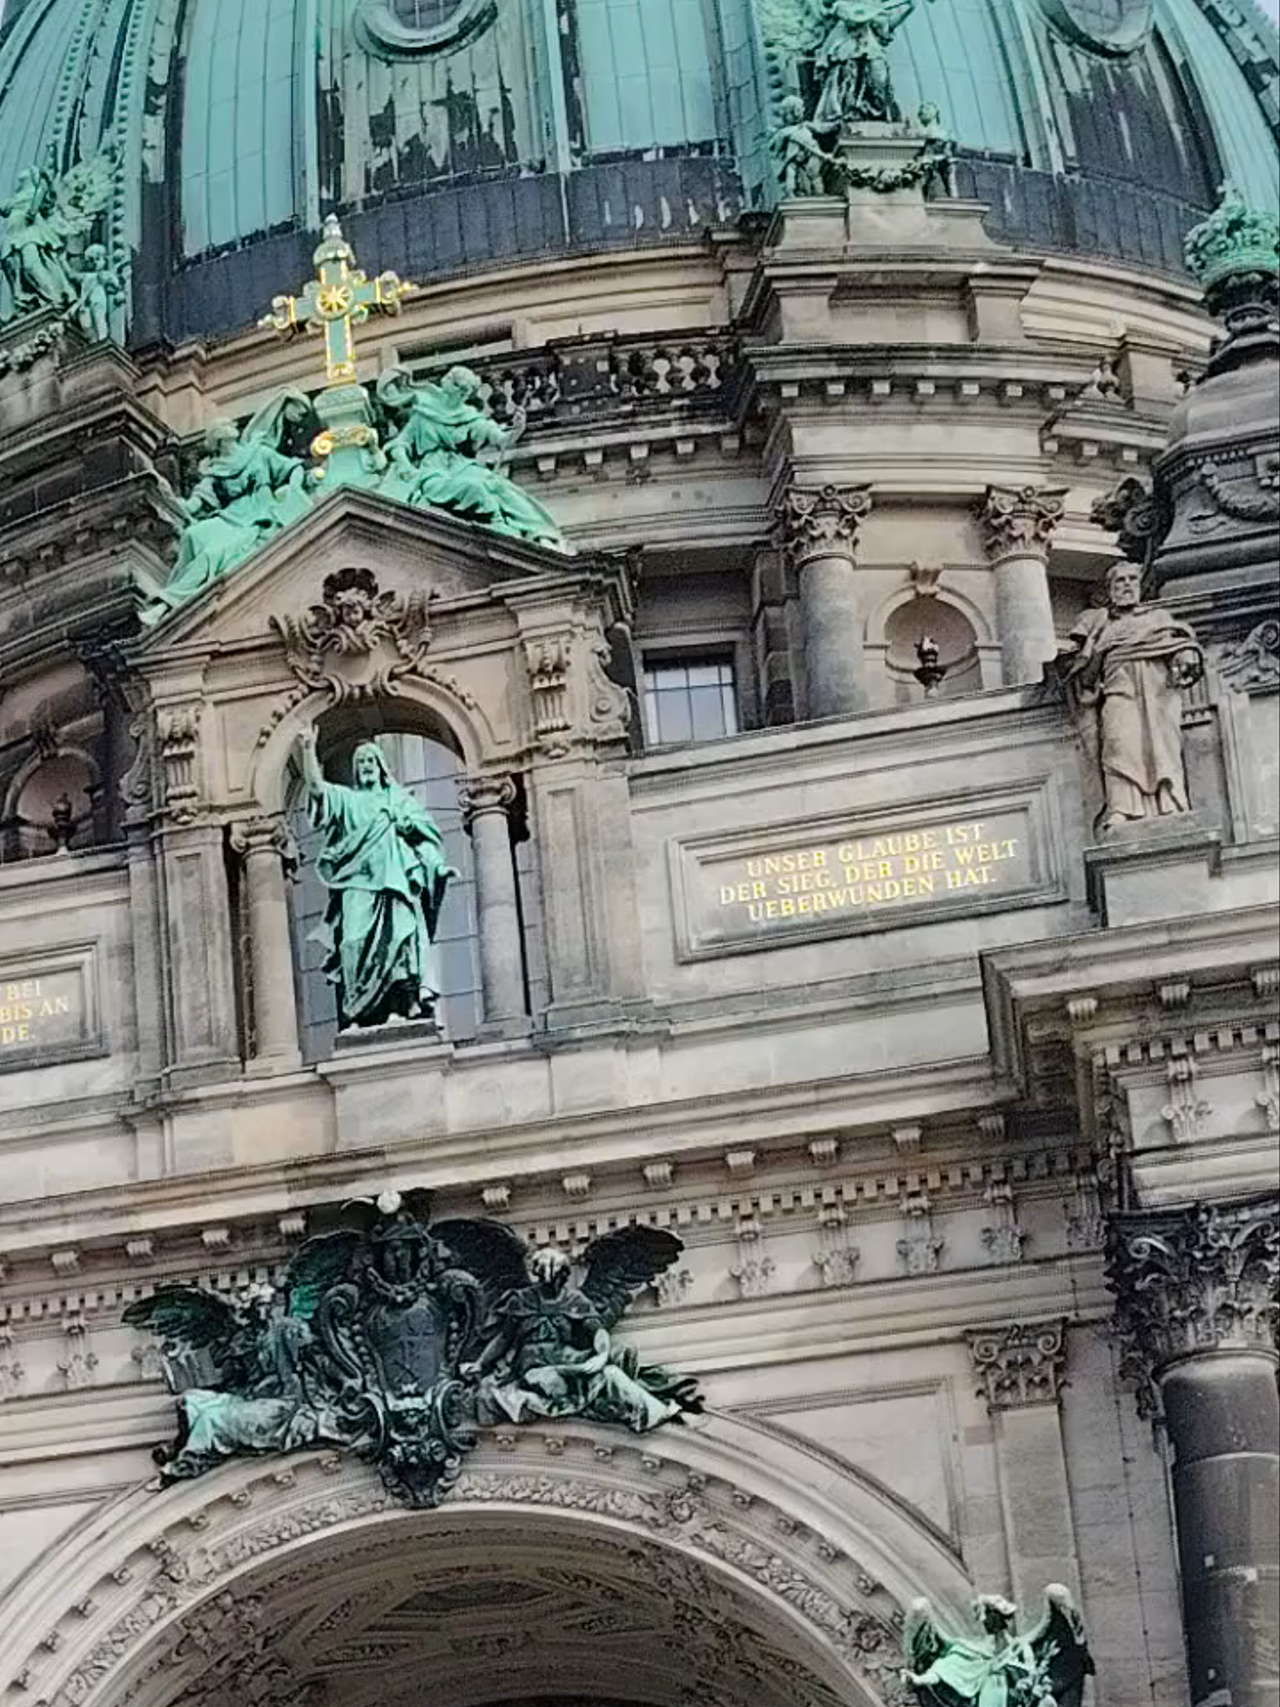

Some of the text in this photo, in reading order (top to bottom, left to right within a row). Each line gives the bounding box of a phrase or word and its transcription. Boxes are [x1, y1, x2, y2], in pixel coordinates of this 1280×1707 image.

[720, 881, 767, 905] DER
[845, 861, 892, 885] DER
[904, 852, 946, 875] DIE
[955, 838, 1018, 867] WELT
[746, 823, 985, 878] UNSER GLAUBE IST
[748, 876, 935, 922] UEBERWUNDEN
[6, 980, 42, 1002] BEI
[40, 995, 70, 1016] AN
